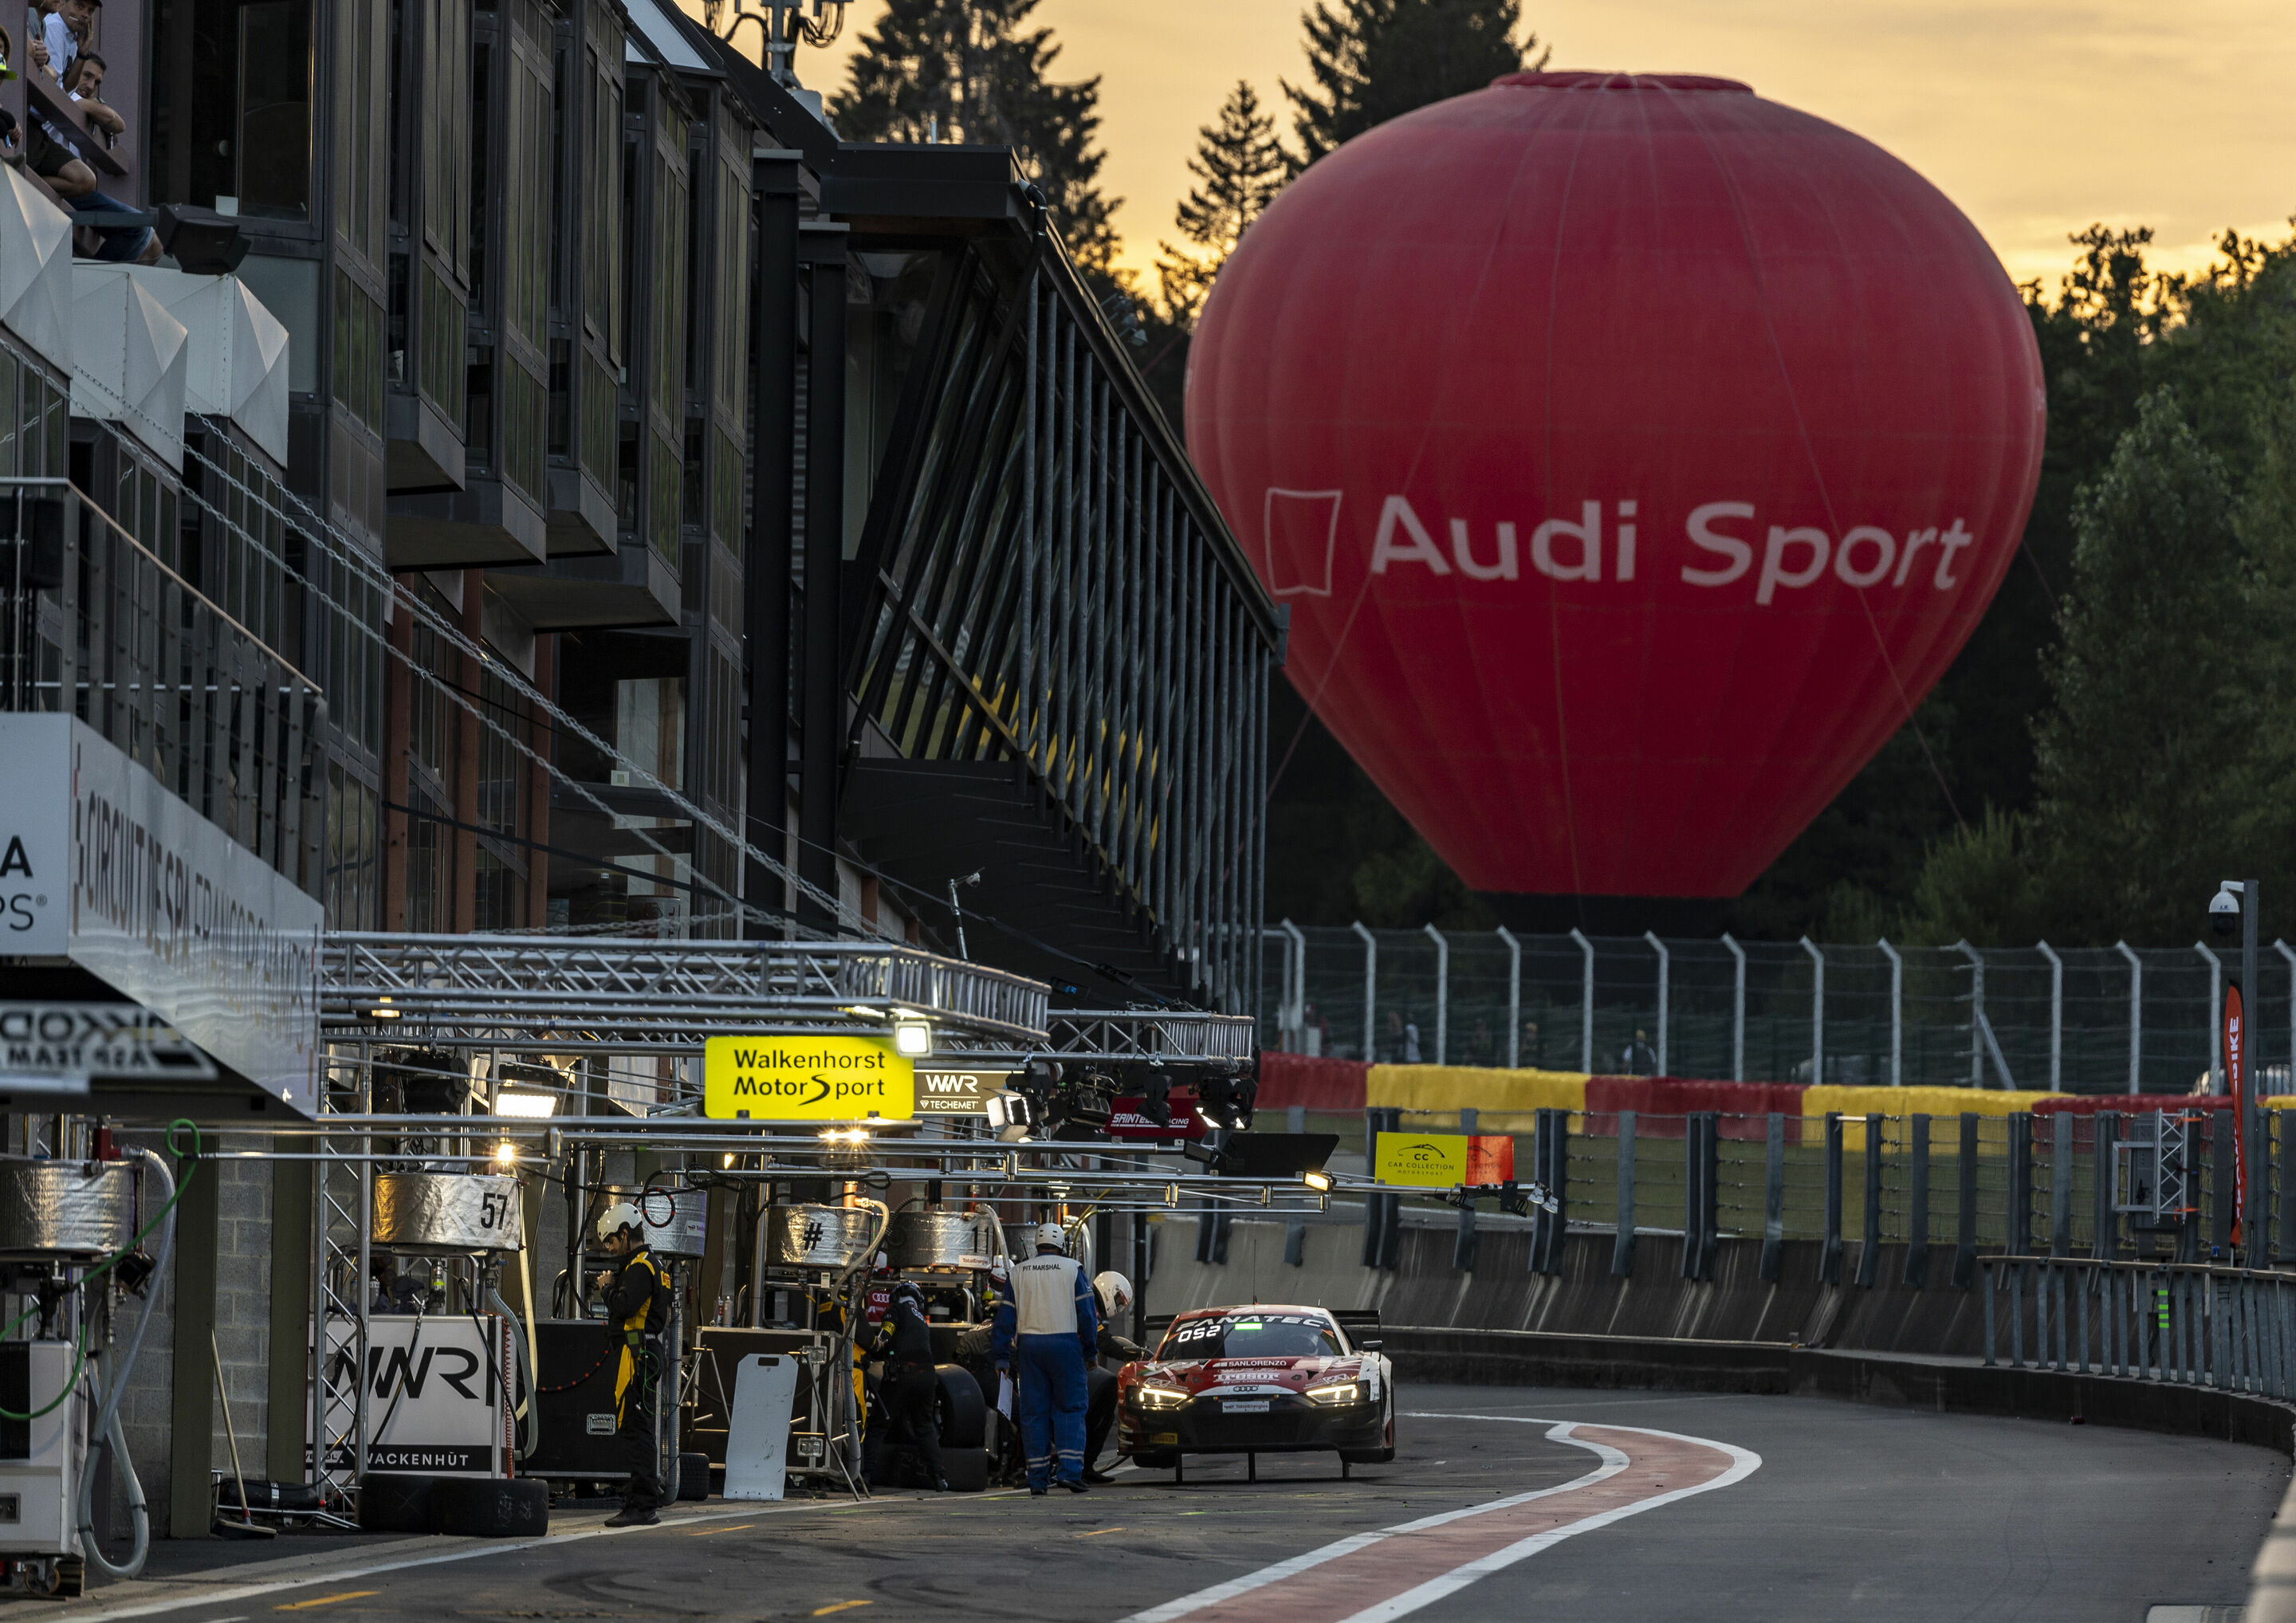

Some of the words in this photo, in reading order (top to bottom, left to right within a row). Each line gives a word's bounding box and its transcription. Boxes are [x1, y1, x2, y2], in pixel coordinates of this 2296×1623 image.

[1370, 496, 1637, 581] Audi
[1681, 501, 1973, 606] Sport
[733, 1050, 885, 1069] Walkenhorst
[925, 1075, 978, 1093] WWR
[930, 1100, 977, 1110] TECHEMET
[481, 1193, 508, 1229] 57
[970, 1225, 989, 1255] 11
[1176, 1315, 1322, 1332] FANATEC
